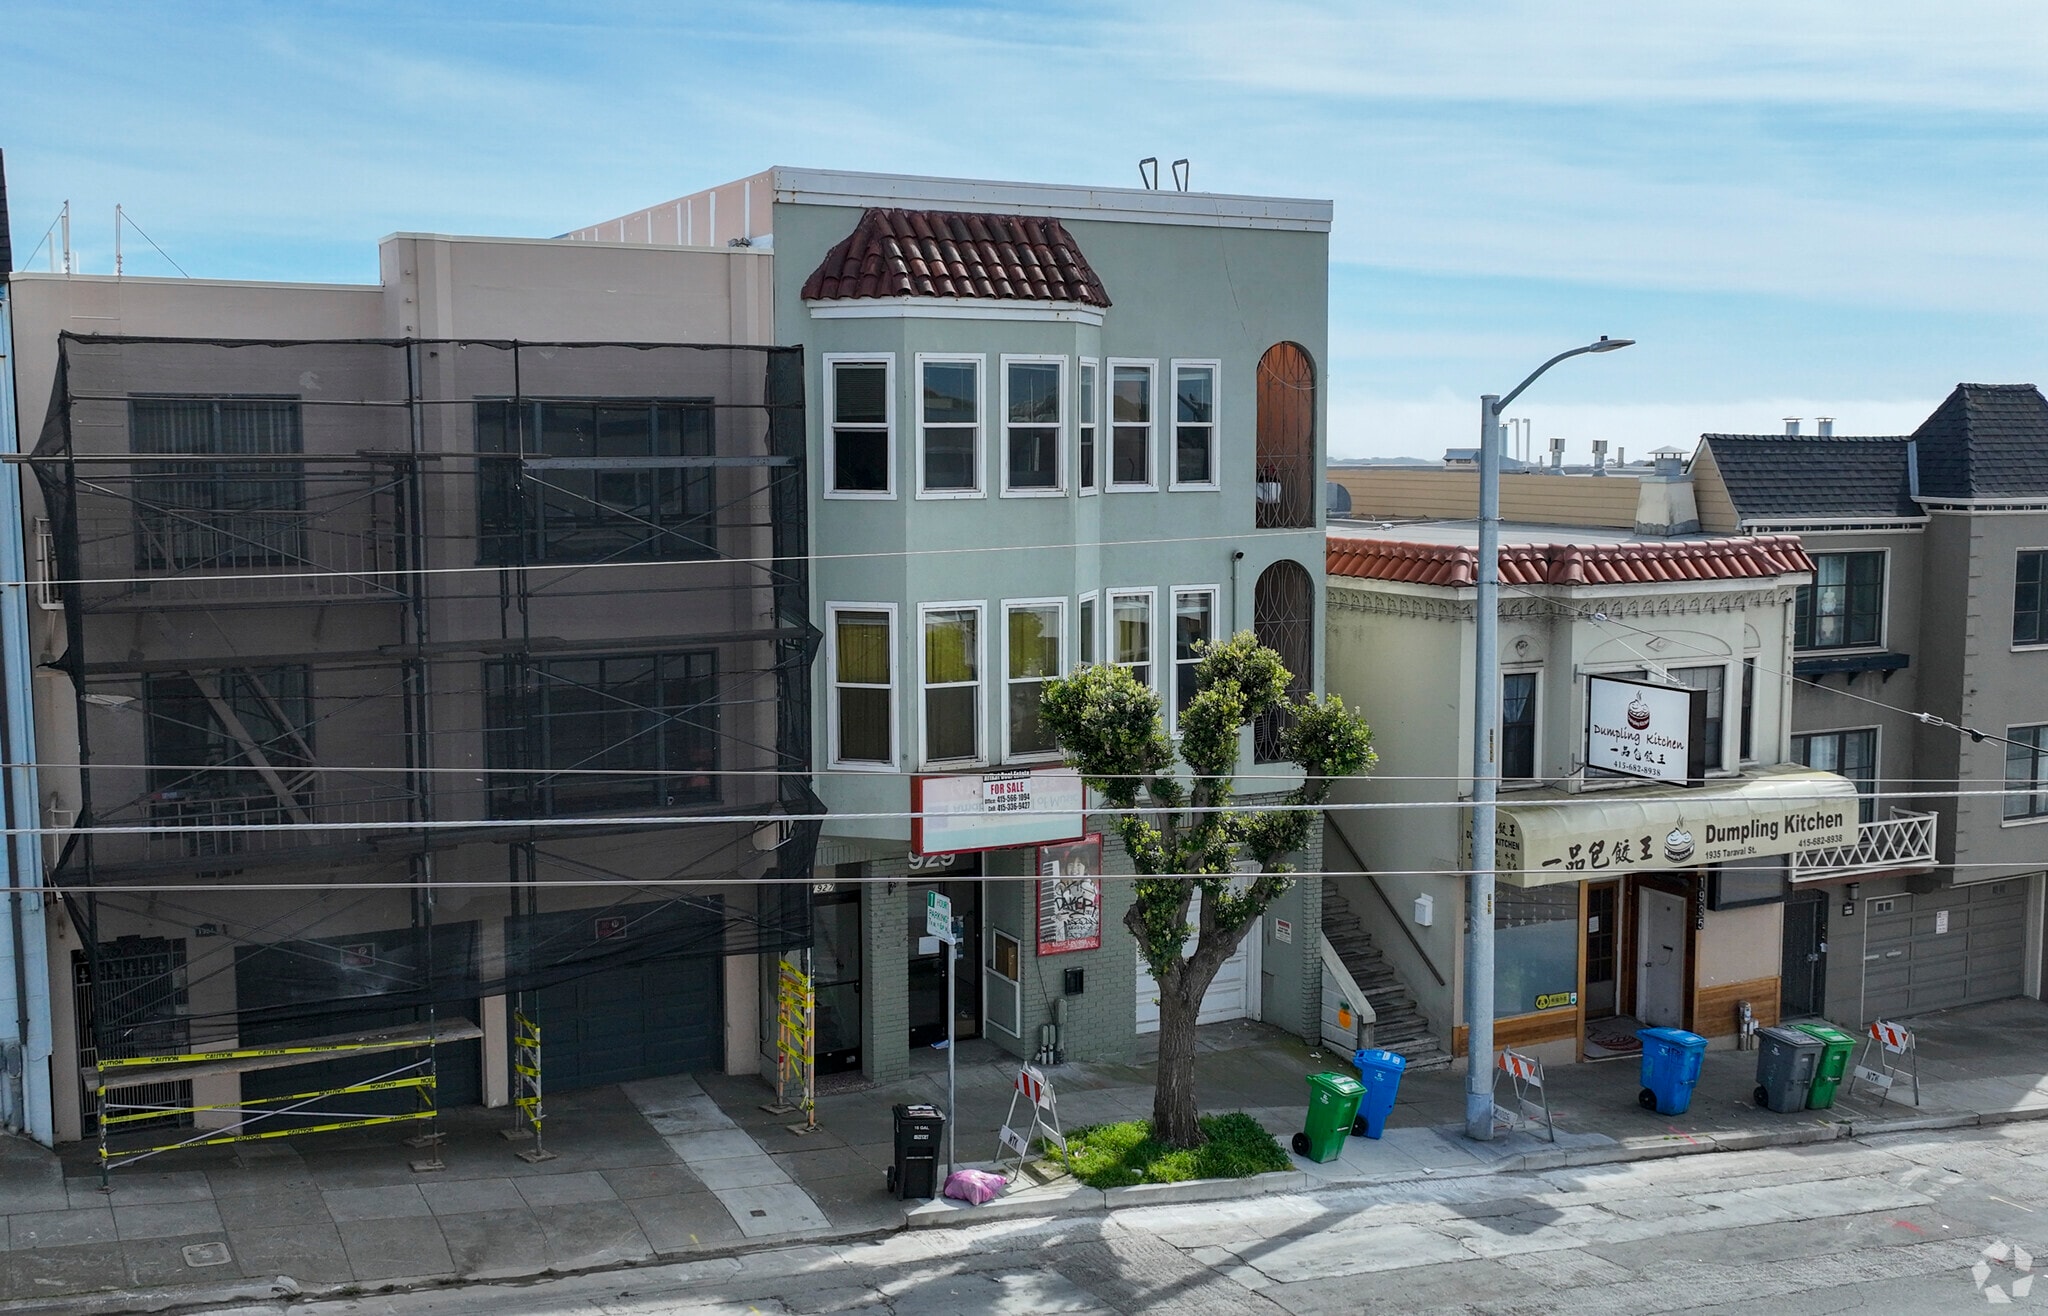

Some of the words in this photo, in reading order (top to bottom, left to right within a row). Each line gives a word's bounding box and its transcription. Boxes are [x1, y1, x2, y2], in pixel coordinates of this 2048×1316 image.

[1594, 725, 1640, 745] Dumpling
[1646, 732, 1684, 749] Kitchen
[1614, 761, 1661, 776] 415-682-8938
[990, 783, 1005, 795] FOR
[1007, 782, 1024, 793] SALE
[1705, 819, 1778, 844] Dumpling
[1784, 811, 1843, 834] Kitchen
[1799, 834, 1843, 847] 415-682-8938
[1705, 850, 1721, 860] 1935
[1723, 848, 1746, 858] Taraval
[1747, 846, 1757, 855] St.
[1697, 877, 1705, 930] 1935
